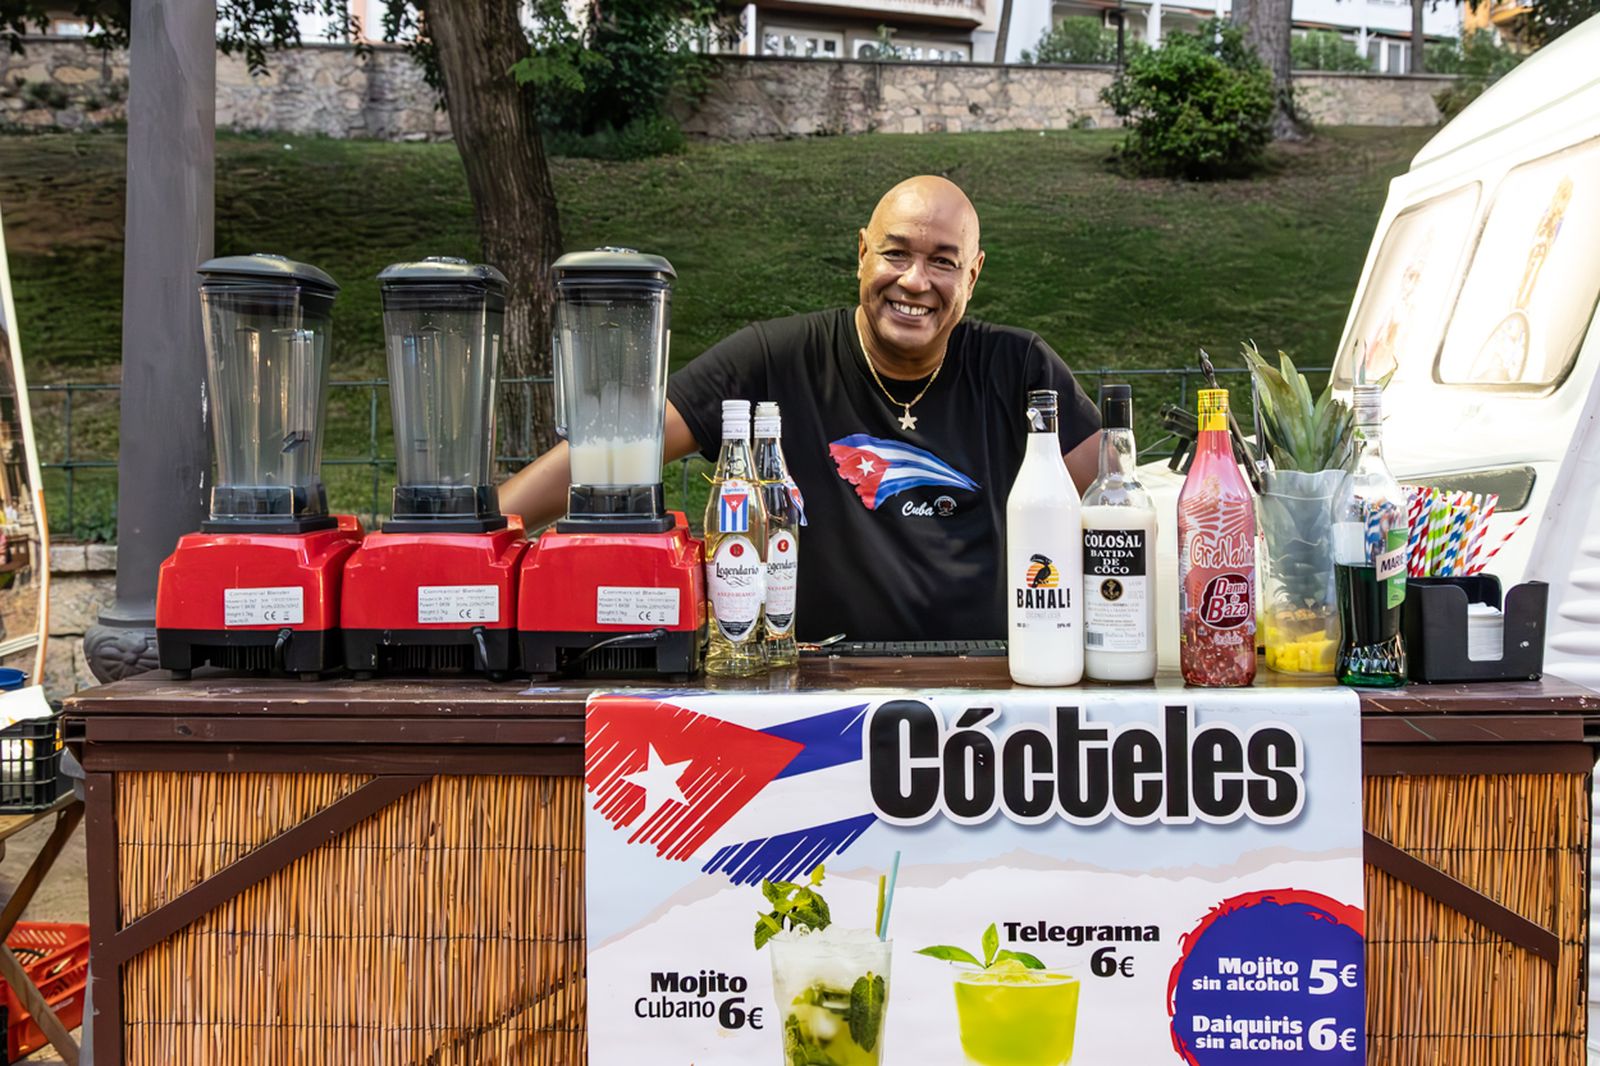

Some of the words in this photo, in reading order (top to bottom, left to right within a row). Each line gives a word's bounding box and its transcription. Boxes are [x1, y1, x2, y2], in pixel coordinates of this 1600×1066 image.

[901, 500, 934, 516] Cuba
[1084, 534, 1142, 548] COLOSAL
[1090, 549, 1134, 557] BATIDA
[1102, 557, 1120, 566] DE
[716, 562, 759, 580] Legendario
[1214, 578, 1248, 598] Dama
[1206, 596, 1250, 623] Baza
[867, 698, 1300, 820] Cócteles
[1003, 921, 1160, 947] Telegrama
[1090, 947, 1135, 978] 6€
[1218, 957, 1299, 979] Mojito
[650, 969, 748, 998] Mojito
[1192, 976, 1221, 990] sin
[1226, 977, 1300, 992] alcohol
[1308, 959, 1358, 995] 5€
[634, 995, 715, 1018] Cubano
[718, 997, 763, 1029] 6€
[1192, 1015, 1303, 1037] Daiquiris
[1308, 1017, 1357, 1051] 6€
[1195, 1034, 1225, 1049] sin
[1229, 1035, 1303, 1051] alcohol
